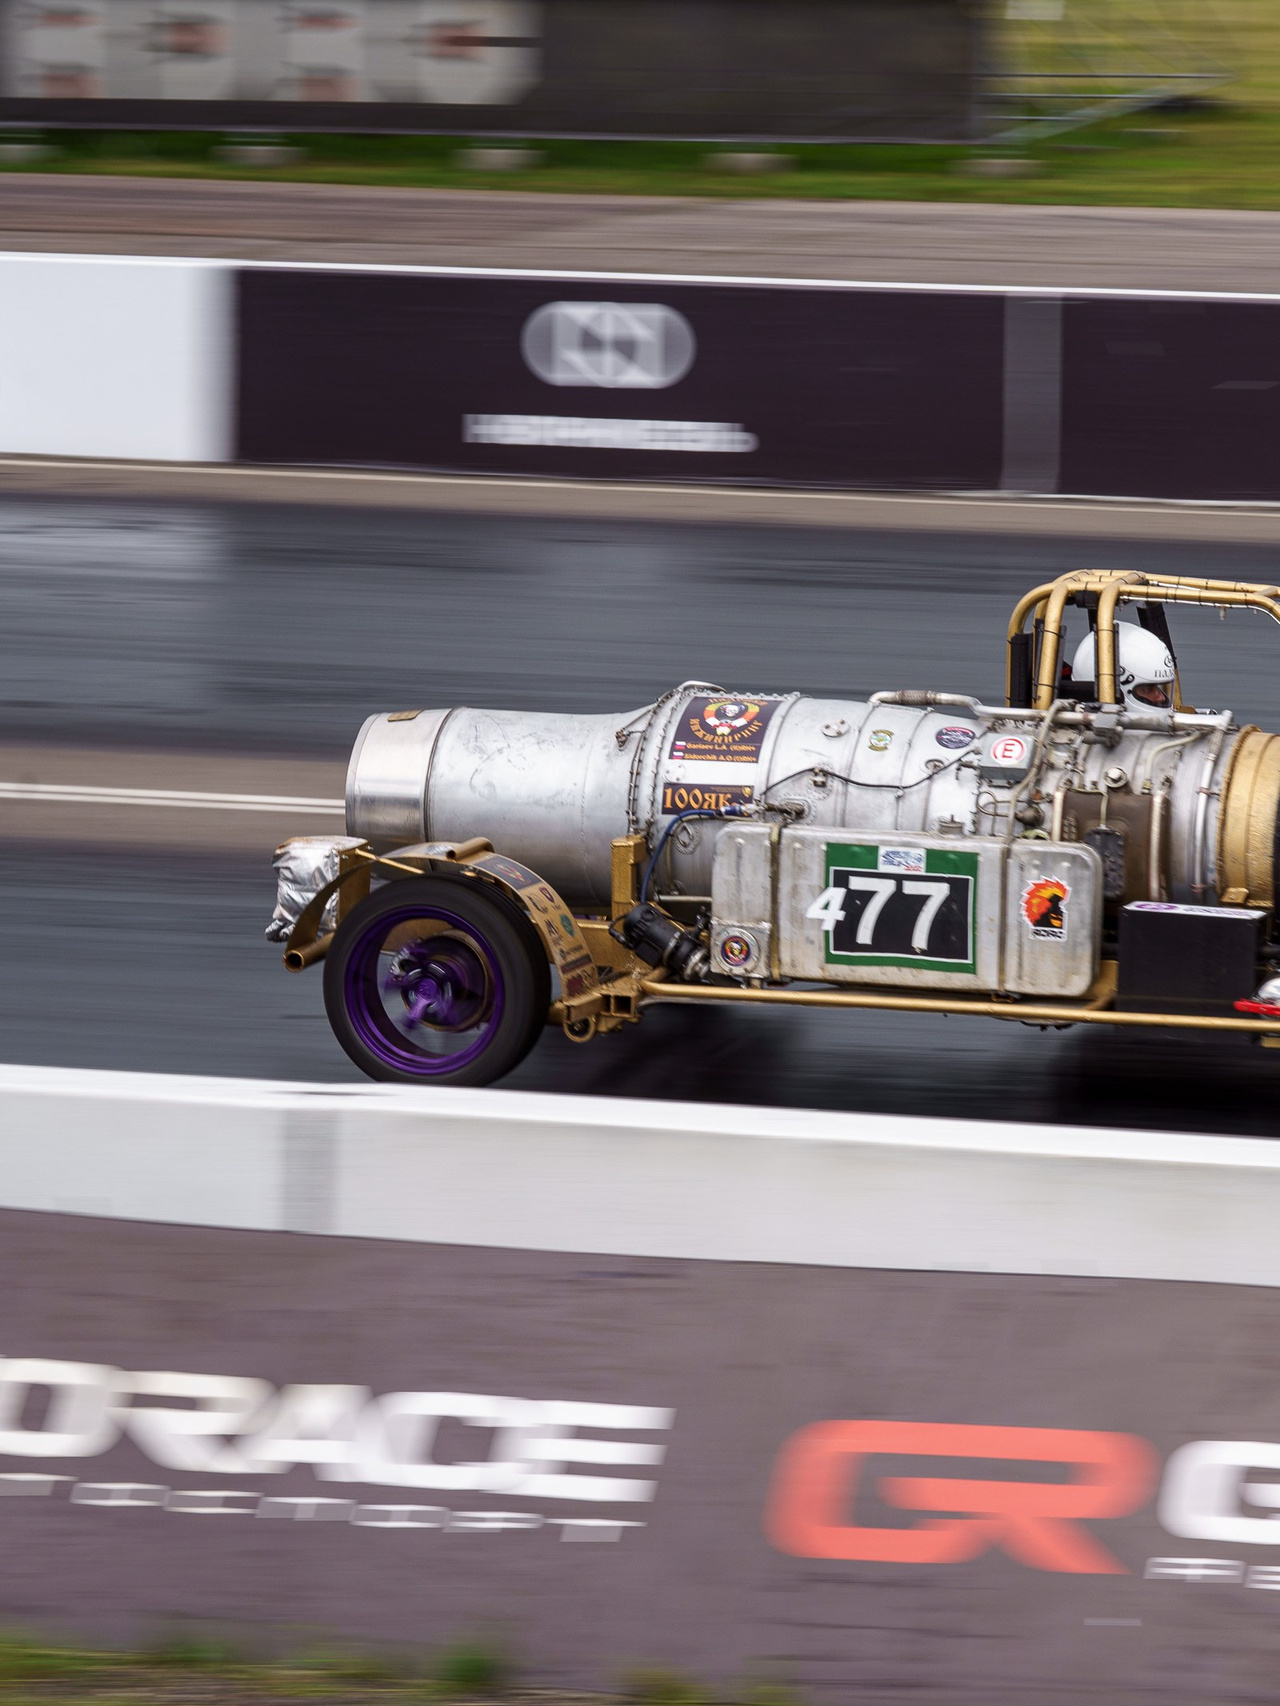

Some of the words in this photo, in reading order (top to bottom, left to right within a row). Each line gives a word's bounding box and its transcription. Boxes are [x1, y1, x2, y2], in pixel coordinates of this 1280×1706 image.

[1002, 743, 1015, 758] E
[806, 875, 950, 951] 477
[0, 1357, 676, 1501] ORACE
[763, 1419, 1161, 1575] GR
